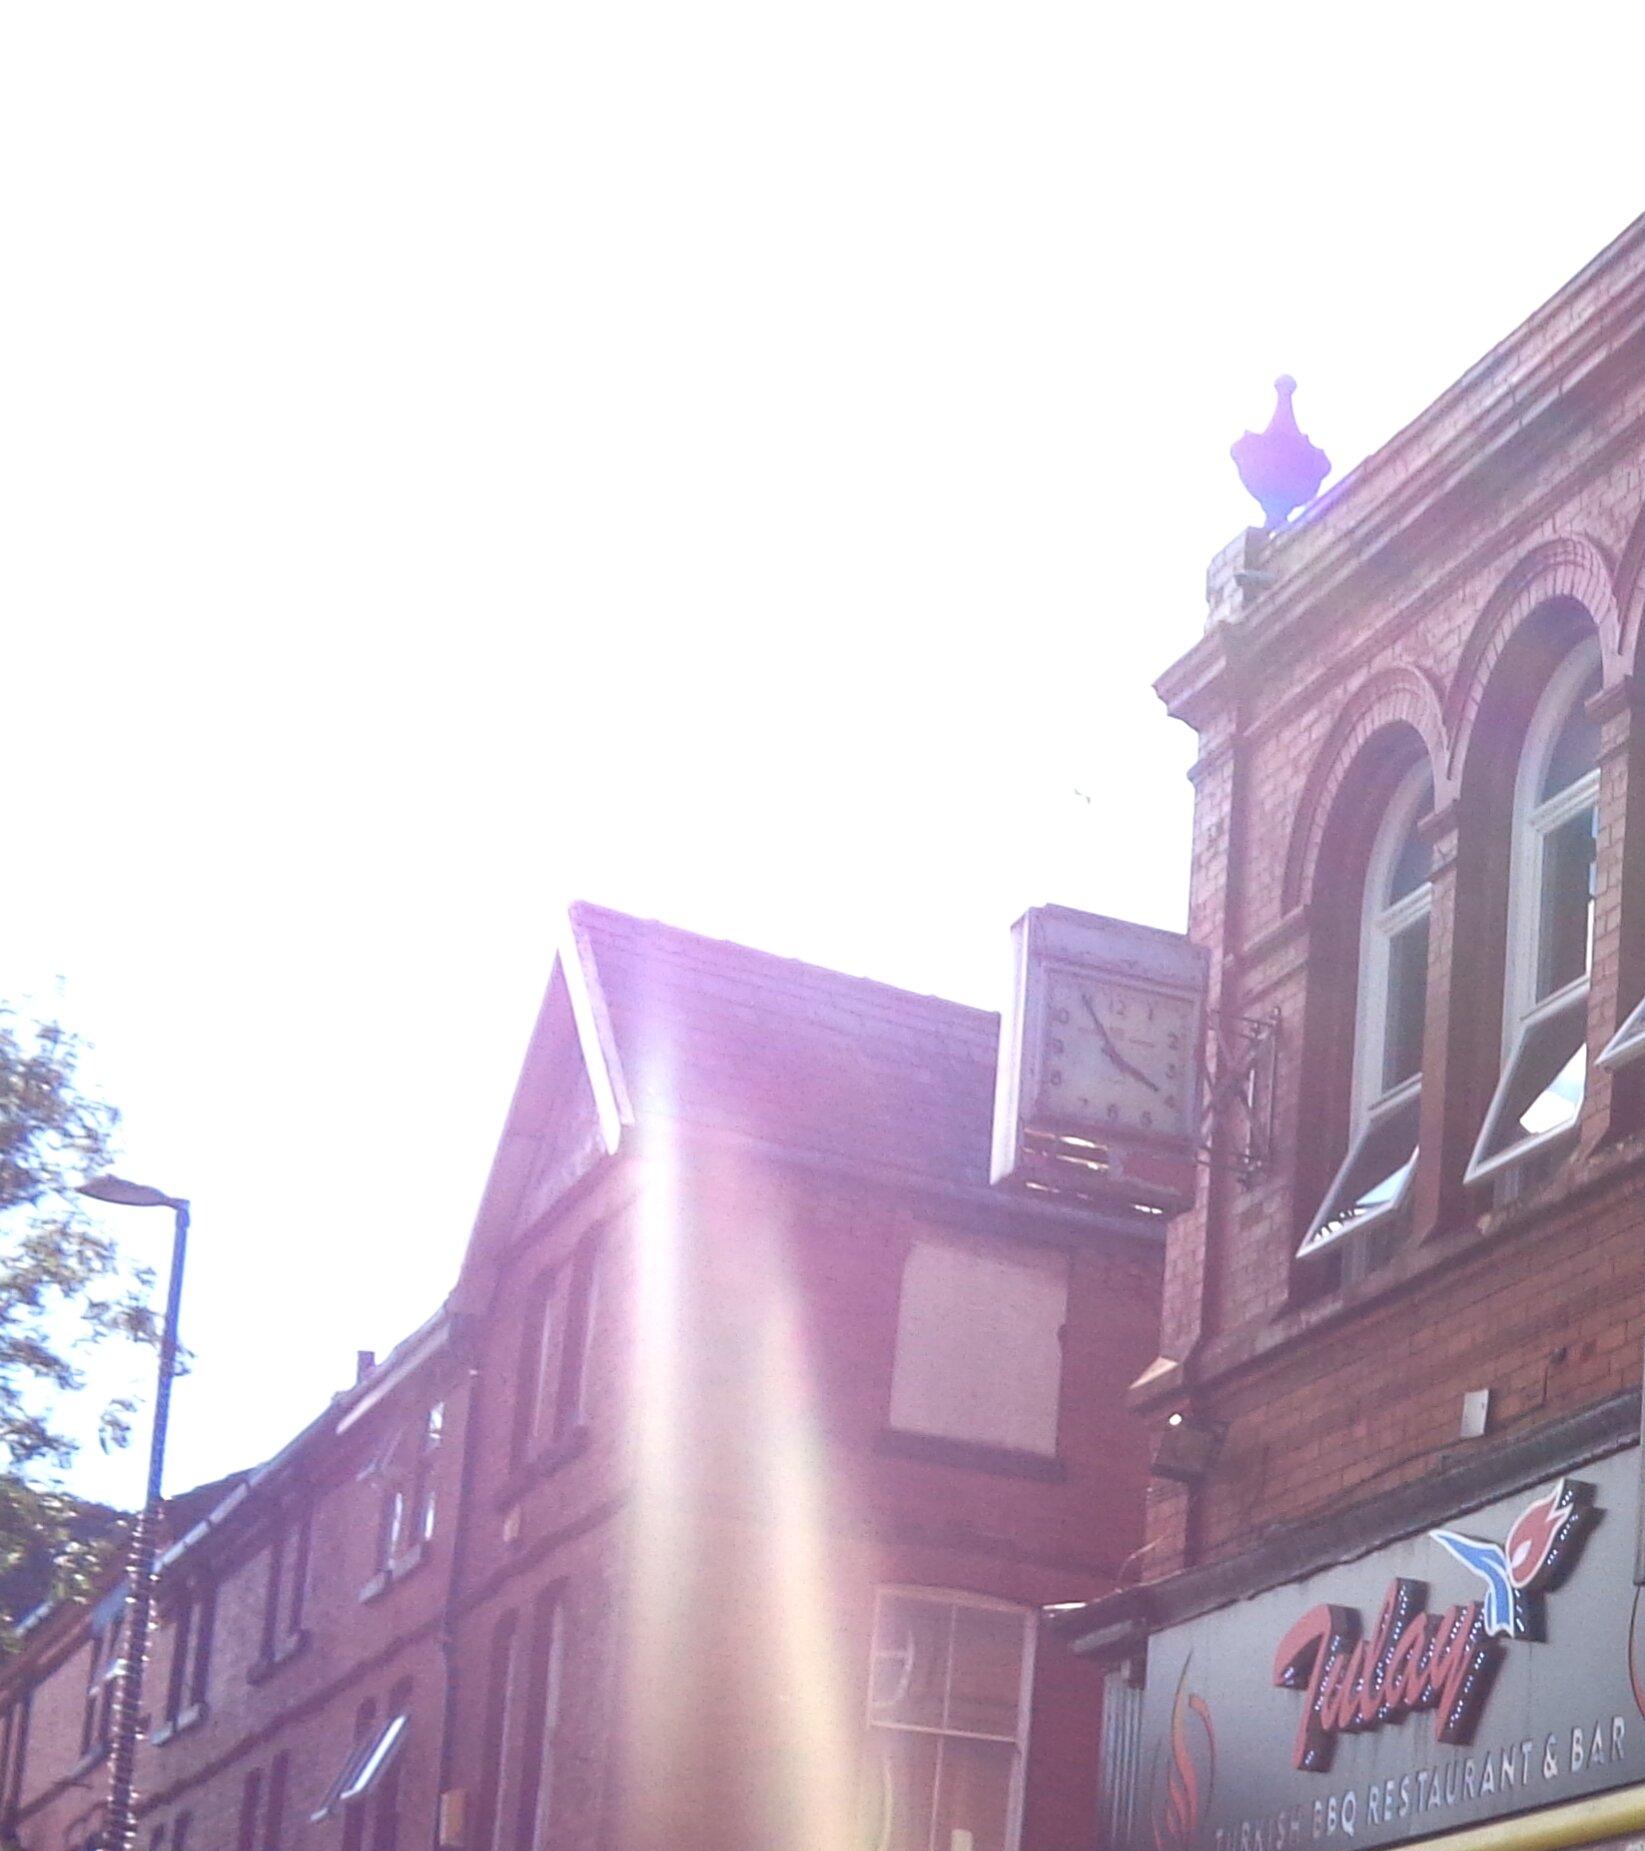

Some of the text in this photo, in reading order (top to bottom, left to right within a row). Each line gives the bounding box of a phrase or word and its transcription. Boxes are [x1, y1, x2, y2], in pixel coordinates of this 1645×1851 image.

[1313, 1790, 1357, 1838] BBQ
[1367, 1739, 1533, 1826] RESTAURANT
[1542, 1732, 1558, 1780] &
[1570, 1715, 1626, 1774] BAR
